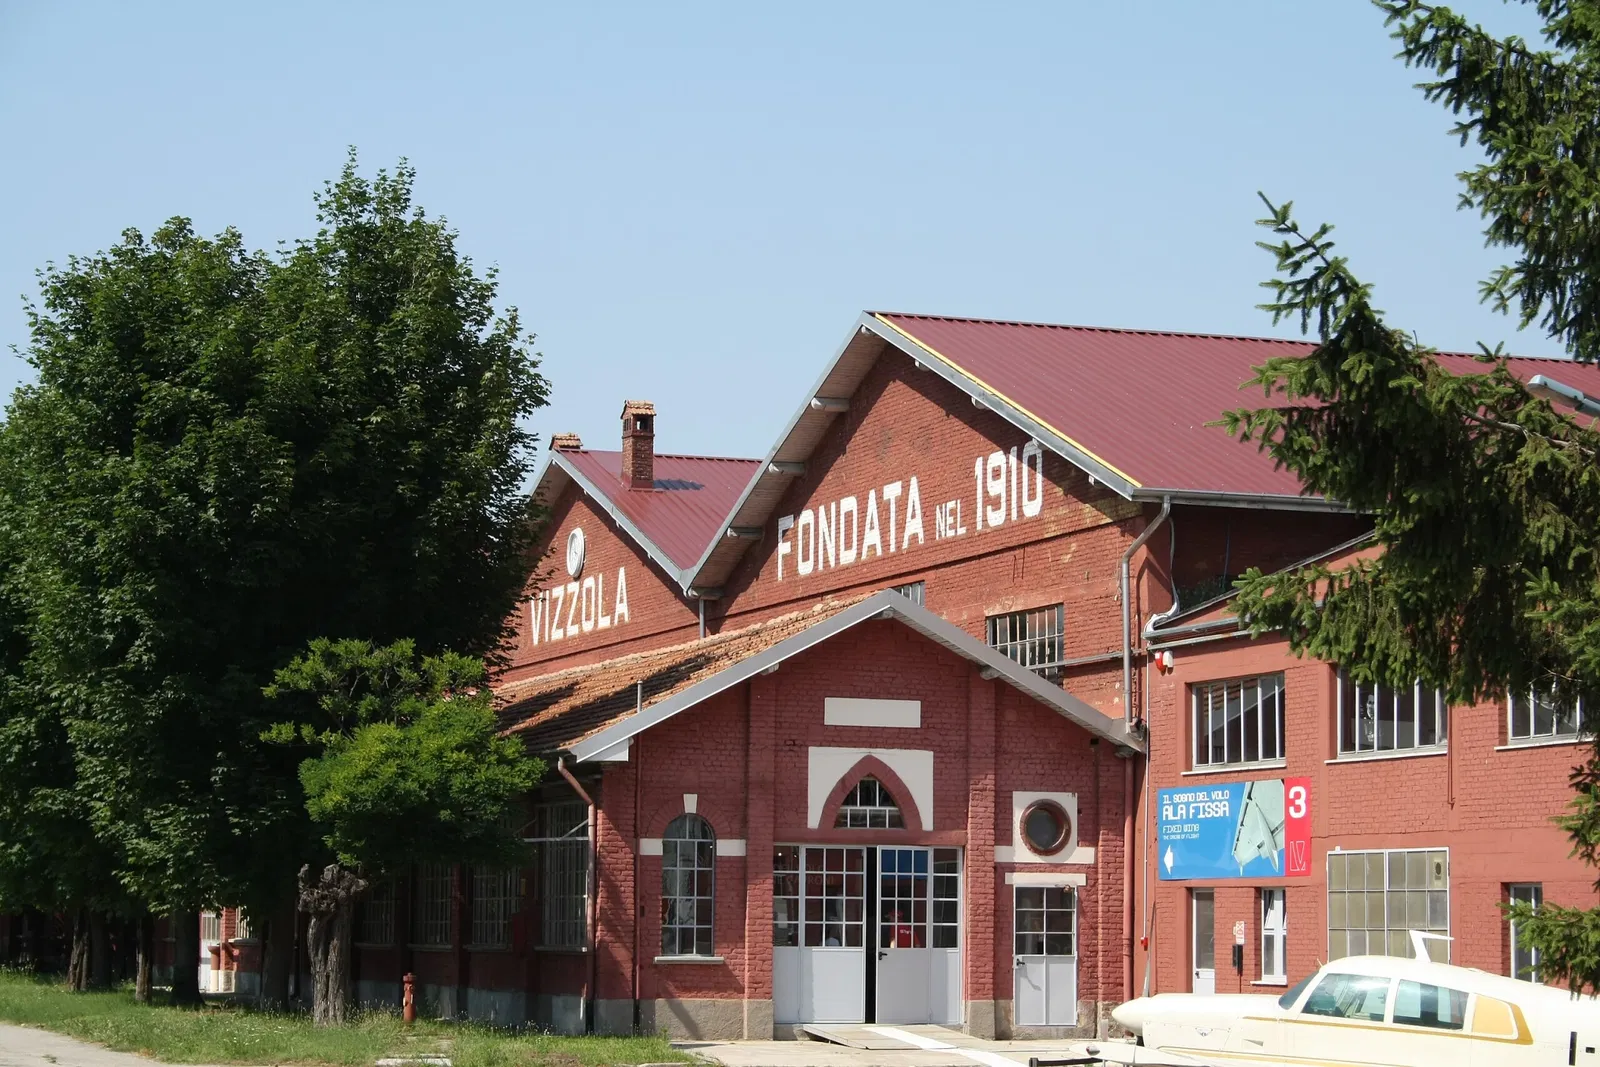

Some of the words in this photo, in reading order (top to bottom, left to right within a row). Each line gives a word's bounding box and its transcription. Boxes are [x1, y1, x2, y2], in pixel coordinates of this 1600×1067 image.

[777, 476, 925, 581] FONDATA
[935, 499, 967, 541] NEL
[974, 438, 1043, 531] 1910
[530, 566, 630, 646] VIZZOLA
[1173, 792, 1196, 803] SOGNO
[1197, 791, 1209, 801] DEL
[1211, 790, 1229, 800] VOLO
[1288, 786, 1307, 819] 3
[1163, 805, 1186, 820] ALA
[1189, 802, 1229, 818] FISSA
[1163, 825, 1182, 833] FIXED
